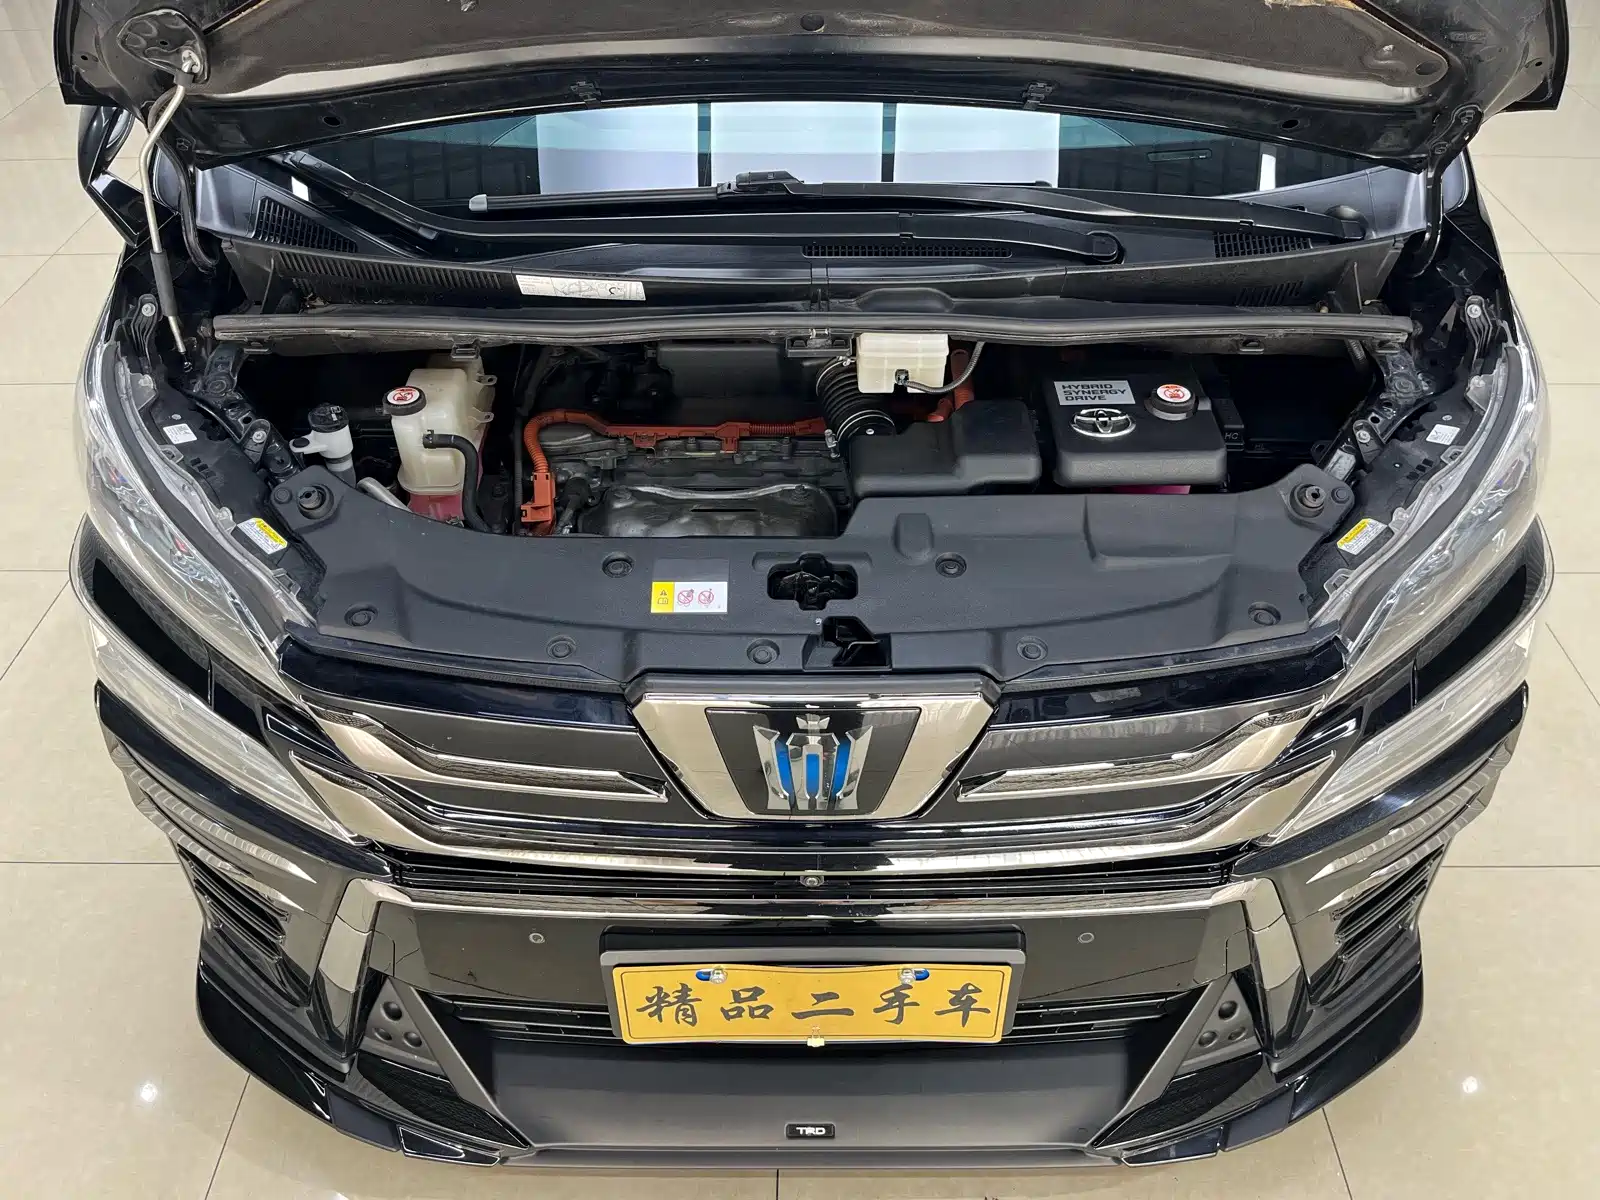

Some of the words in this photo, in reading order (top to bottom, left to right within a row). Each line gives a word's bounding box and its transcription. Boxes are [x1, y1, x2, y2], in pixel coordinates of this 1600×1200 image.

[636, 983, 991, 1027] 精品二手车
[795, 1126, 826, 1136] TRD
